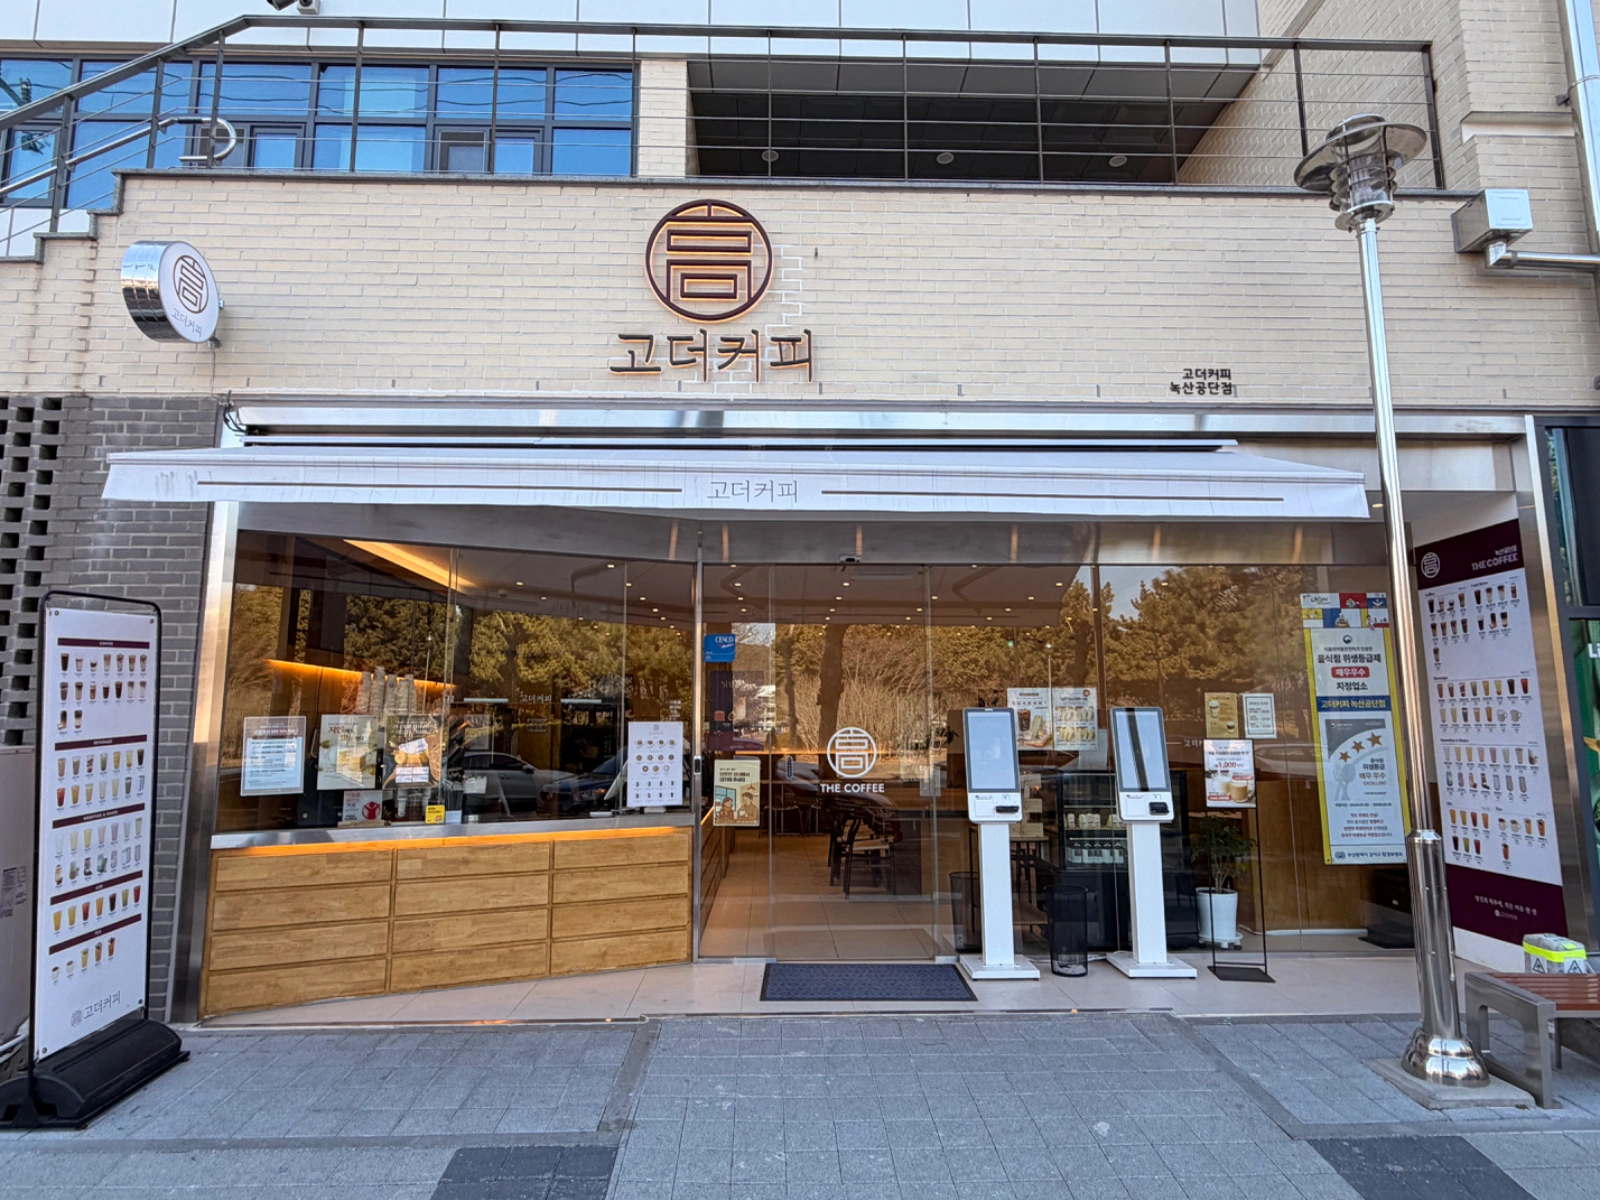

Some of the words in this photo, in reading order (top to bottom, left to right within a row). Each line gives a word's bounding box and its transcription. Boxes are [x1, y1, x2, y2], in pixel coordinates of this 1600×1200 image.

[171, 308, 203, 338] 고더커피
[609, 328, 814, 383] 고더커피
[1182, 368, 1232, 381] 고더커피
[1169, 381, 1233, 395] 녹산공단점
[706, 479, 798, 503] 고더커피
[1471, 560, 1487, 571] THE
[1486, 553, 1518, 567] COFFEE
[1317, 653, 1341, 663] 음식점
[1343, 653, 1382, 663] 위생등급제
[1335, 667, 1366, 677] 매우우수
[1336, 681, 1368, 691] 지정업소
[820, 783, 841, 793] THE
[843, 783, 885, 793] COFFEE
[83, 990, 121, 1020] 고더커피
